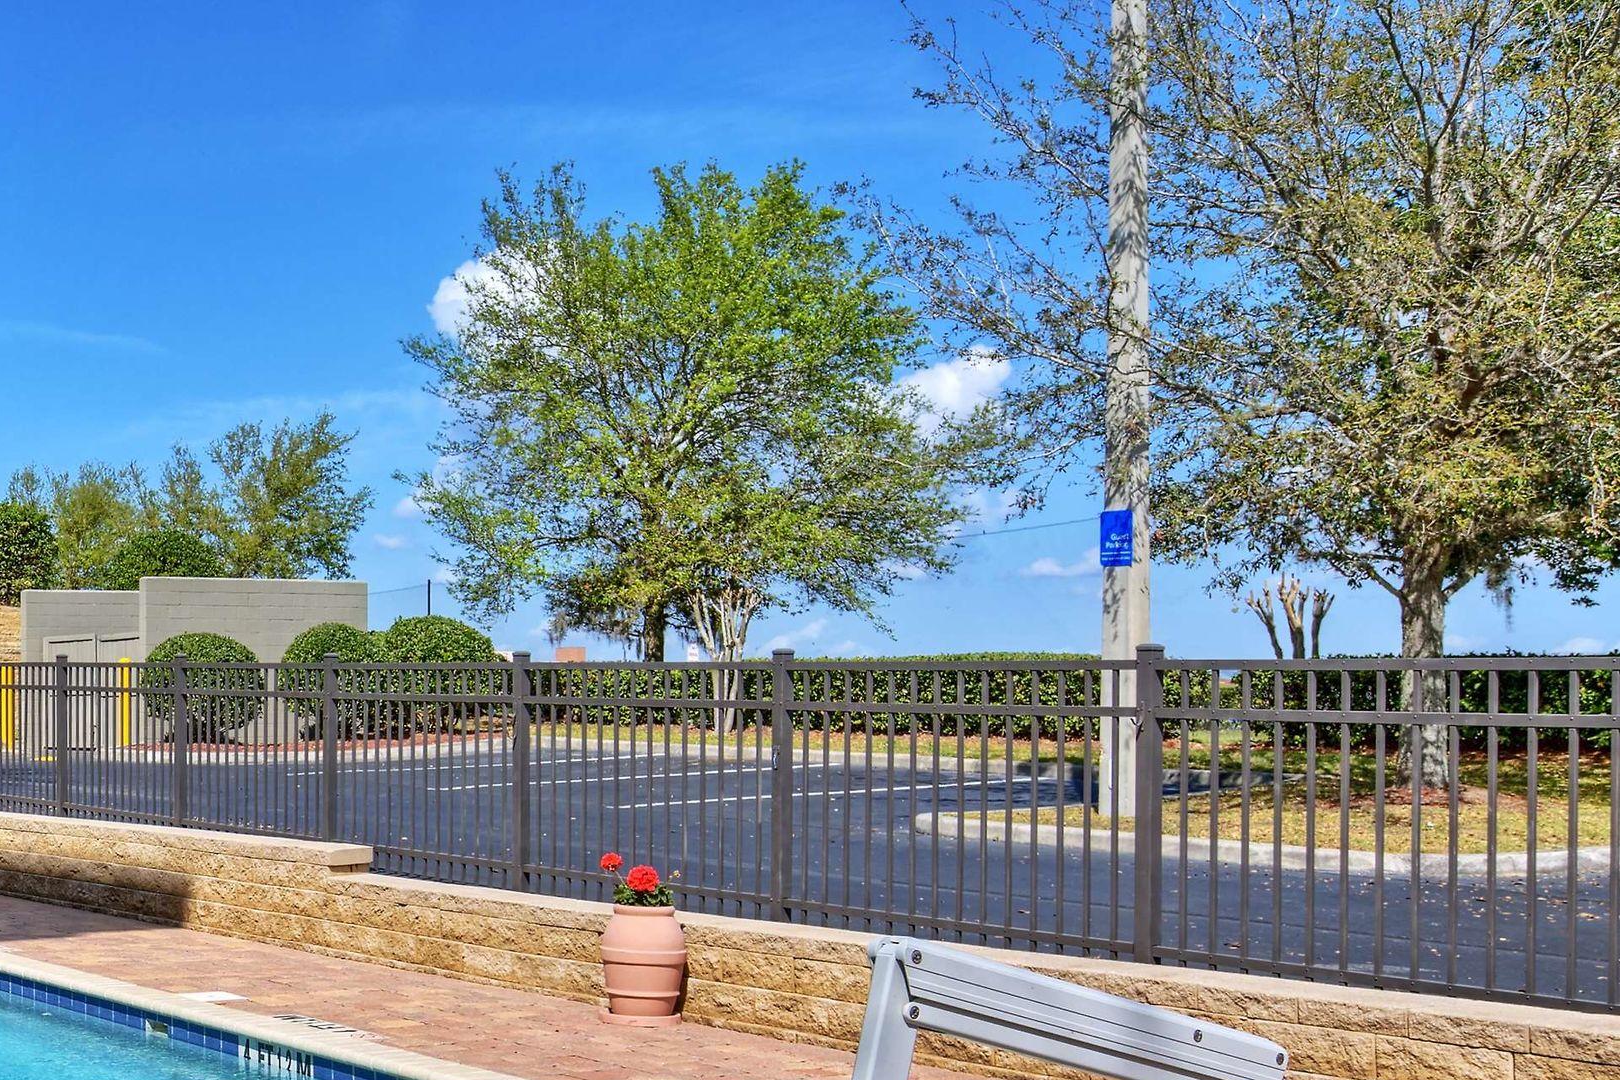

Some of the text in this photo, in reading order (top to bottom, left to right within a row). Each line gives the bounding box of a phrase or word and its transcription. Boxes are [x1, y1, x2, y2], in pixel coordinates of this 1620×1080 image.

[243, 1038, 251, 1060] 4
[258, 1041, 274, 1066] FT
[296, 1052, 311, 1077] M
